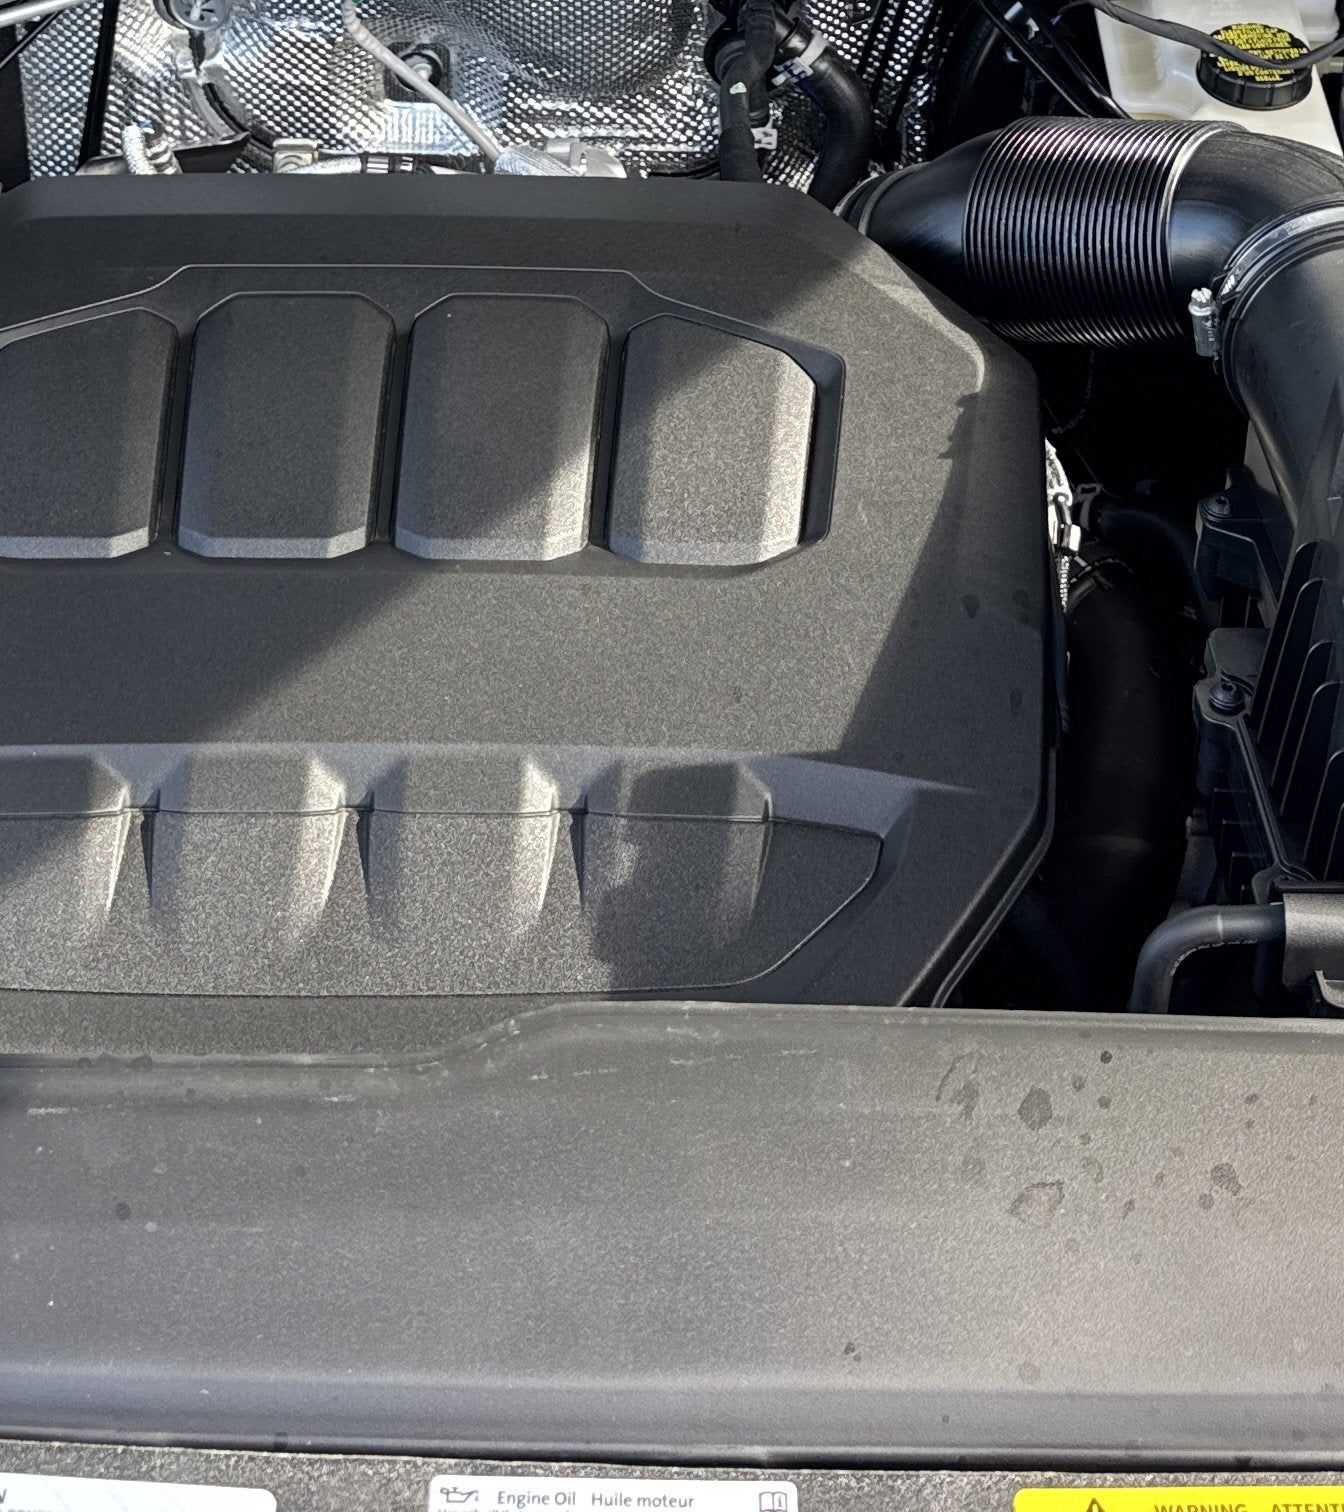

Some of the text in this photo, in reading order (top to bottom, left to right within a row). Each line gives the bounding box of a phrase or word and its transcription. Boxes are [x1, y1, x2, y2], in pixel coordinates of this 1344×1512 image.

[498, 1491, 576, 1510] Engine Oil
[591, 1492, 695, 1509] Huile moteur
